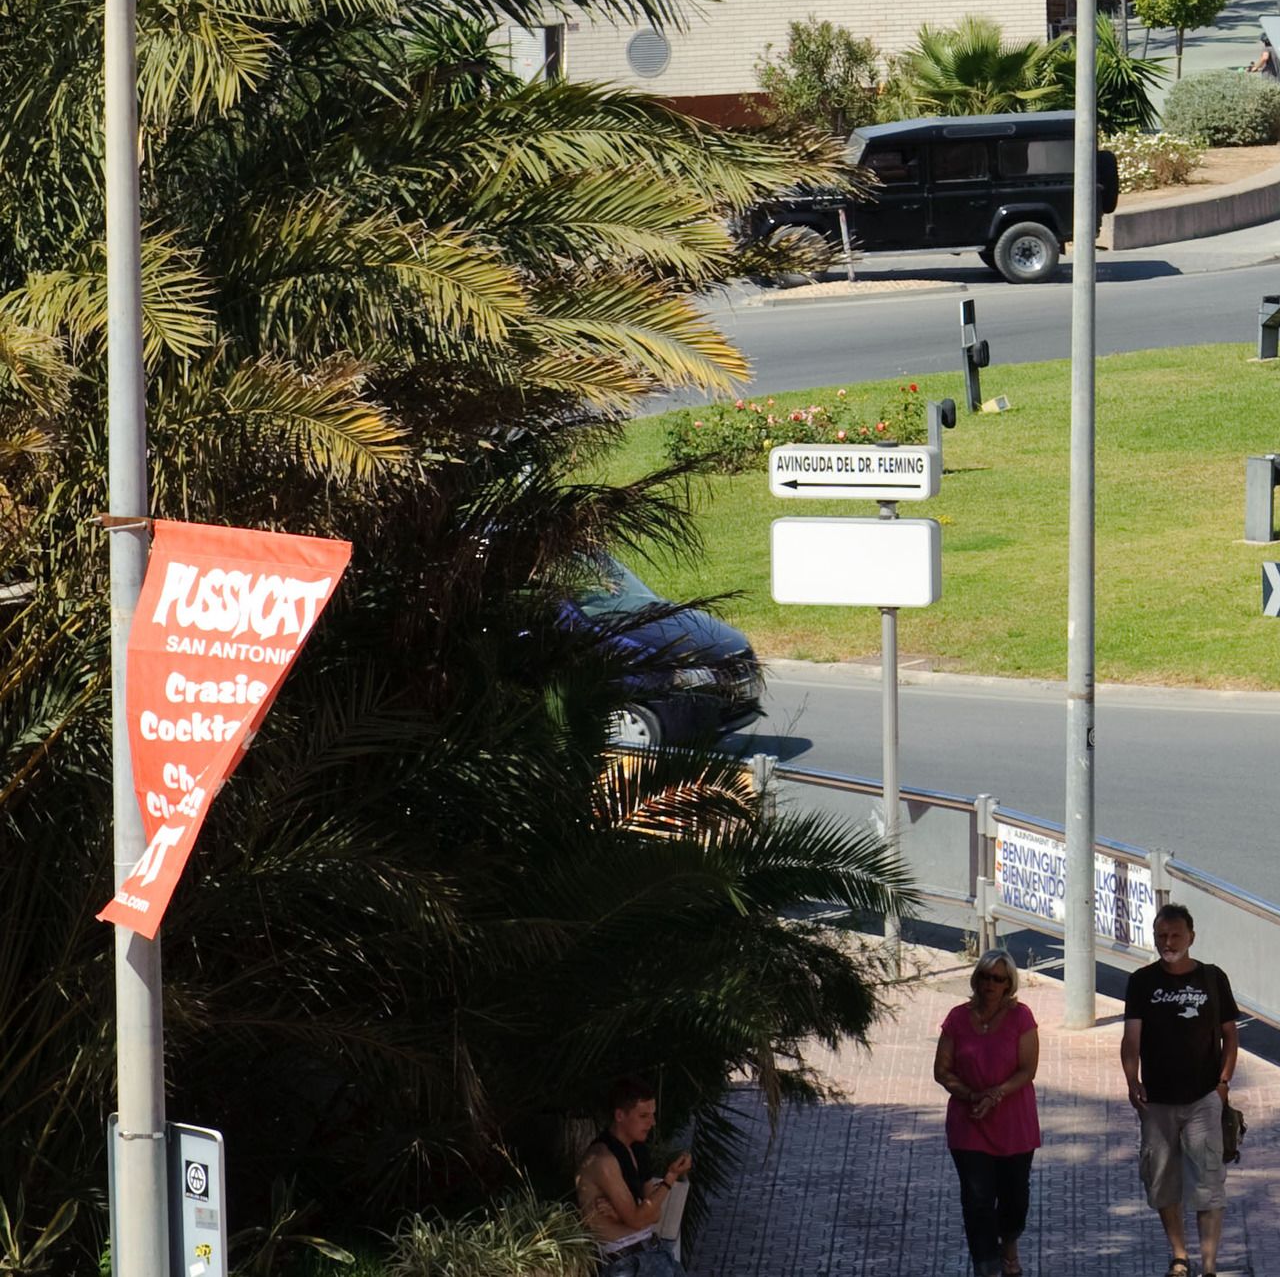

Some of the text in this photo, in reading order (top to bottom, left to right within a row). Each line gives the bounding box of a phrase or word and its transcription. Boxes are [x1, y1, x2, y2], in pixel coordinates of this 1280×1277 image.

[776, 456, 924, 474] AVINGUDA DEL DR. FLEMING
[152, 561, 331, 644] PUSSYCAT
[165, 634, 206, 656] SAN
[165, 671, 268, 703] Crazie
[1002, 884, 1054, 919] WELCOME
[1151, 988, 1208, 1005] Stingray
